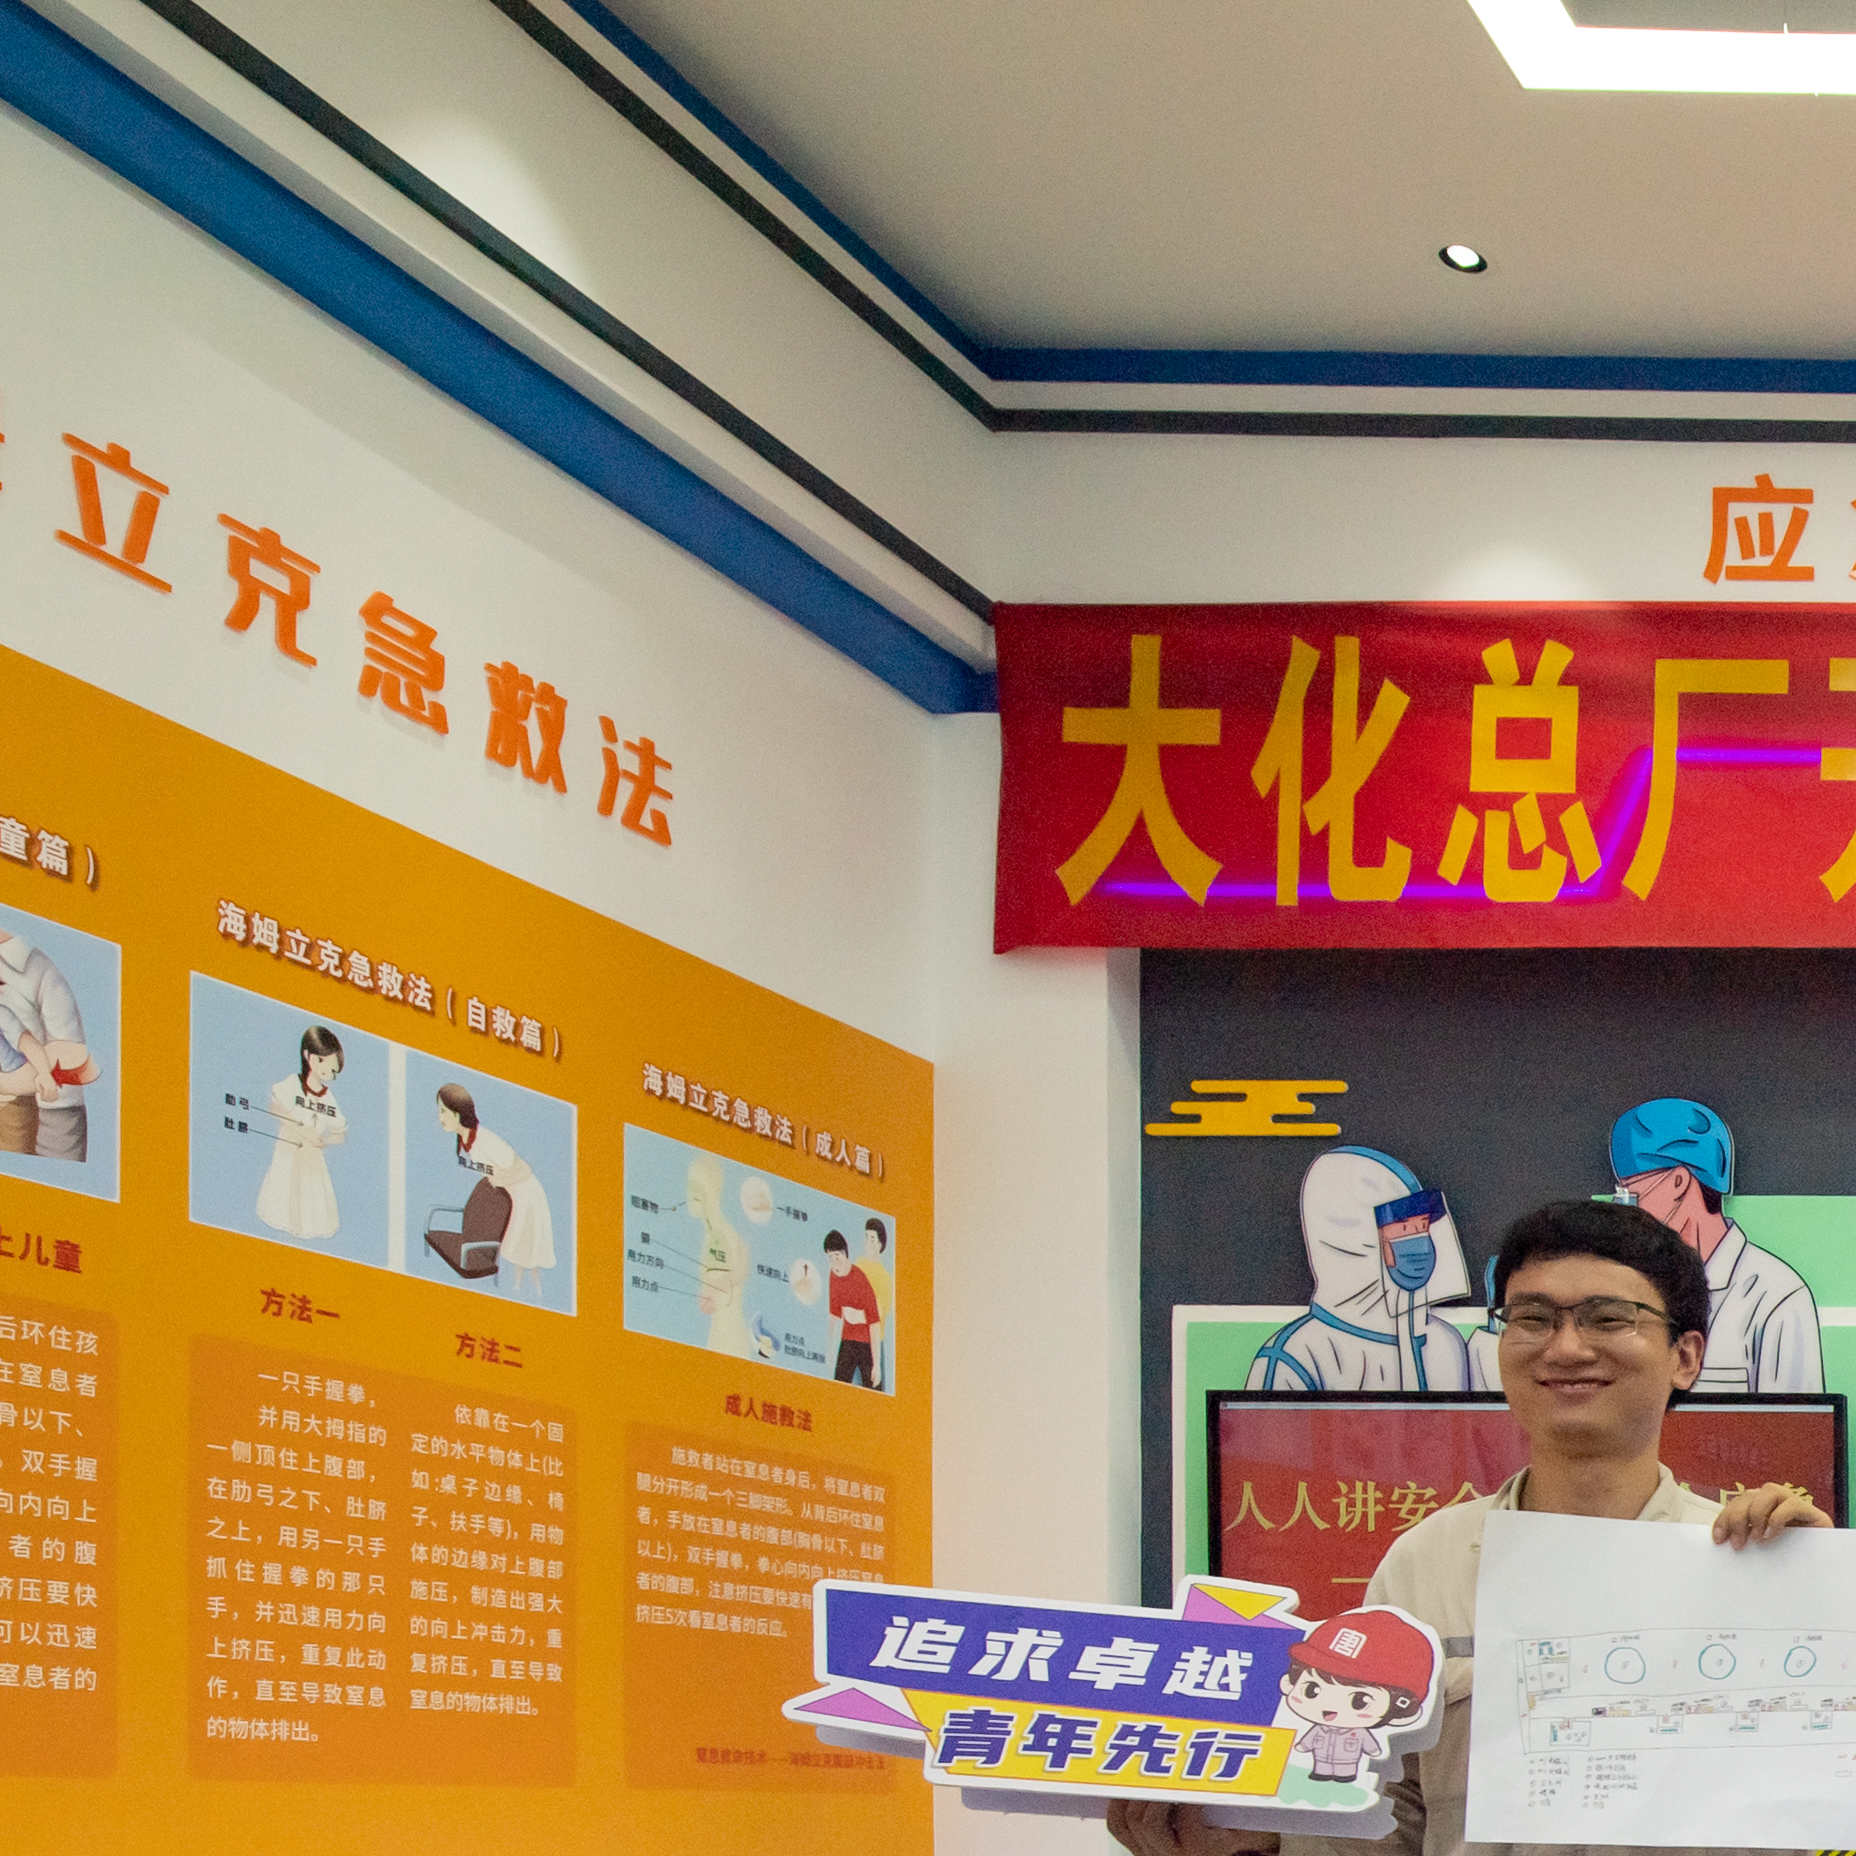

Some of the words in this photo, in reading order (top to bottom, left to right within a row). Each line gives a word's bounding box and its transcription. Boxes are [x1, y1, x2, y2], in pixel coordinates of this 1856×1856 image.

[0, 431, 673, 847] 立克急救法
[260, 1287, 340, 1324] 方法一
[455, 1331, 523, 1369] 方法二
[259, 1405, 387, 1447] 并用大拇指的
[454, 1404, 563, 1443] 依靠在一个固
[725, 1393, 813, 1432] 成人施救法
[206, 1556, 386, 1596] 抓住握拳的那只
[410, 1542, 564, 1580] 体的边缘对上腹部
[868, 1615, 1253, 1700] 追求卓越
[206, 1716, 319, 1743] 的物体排出。
[937, 1707, 1266, 1781] 青年先行
